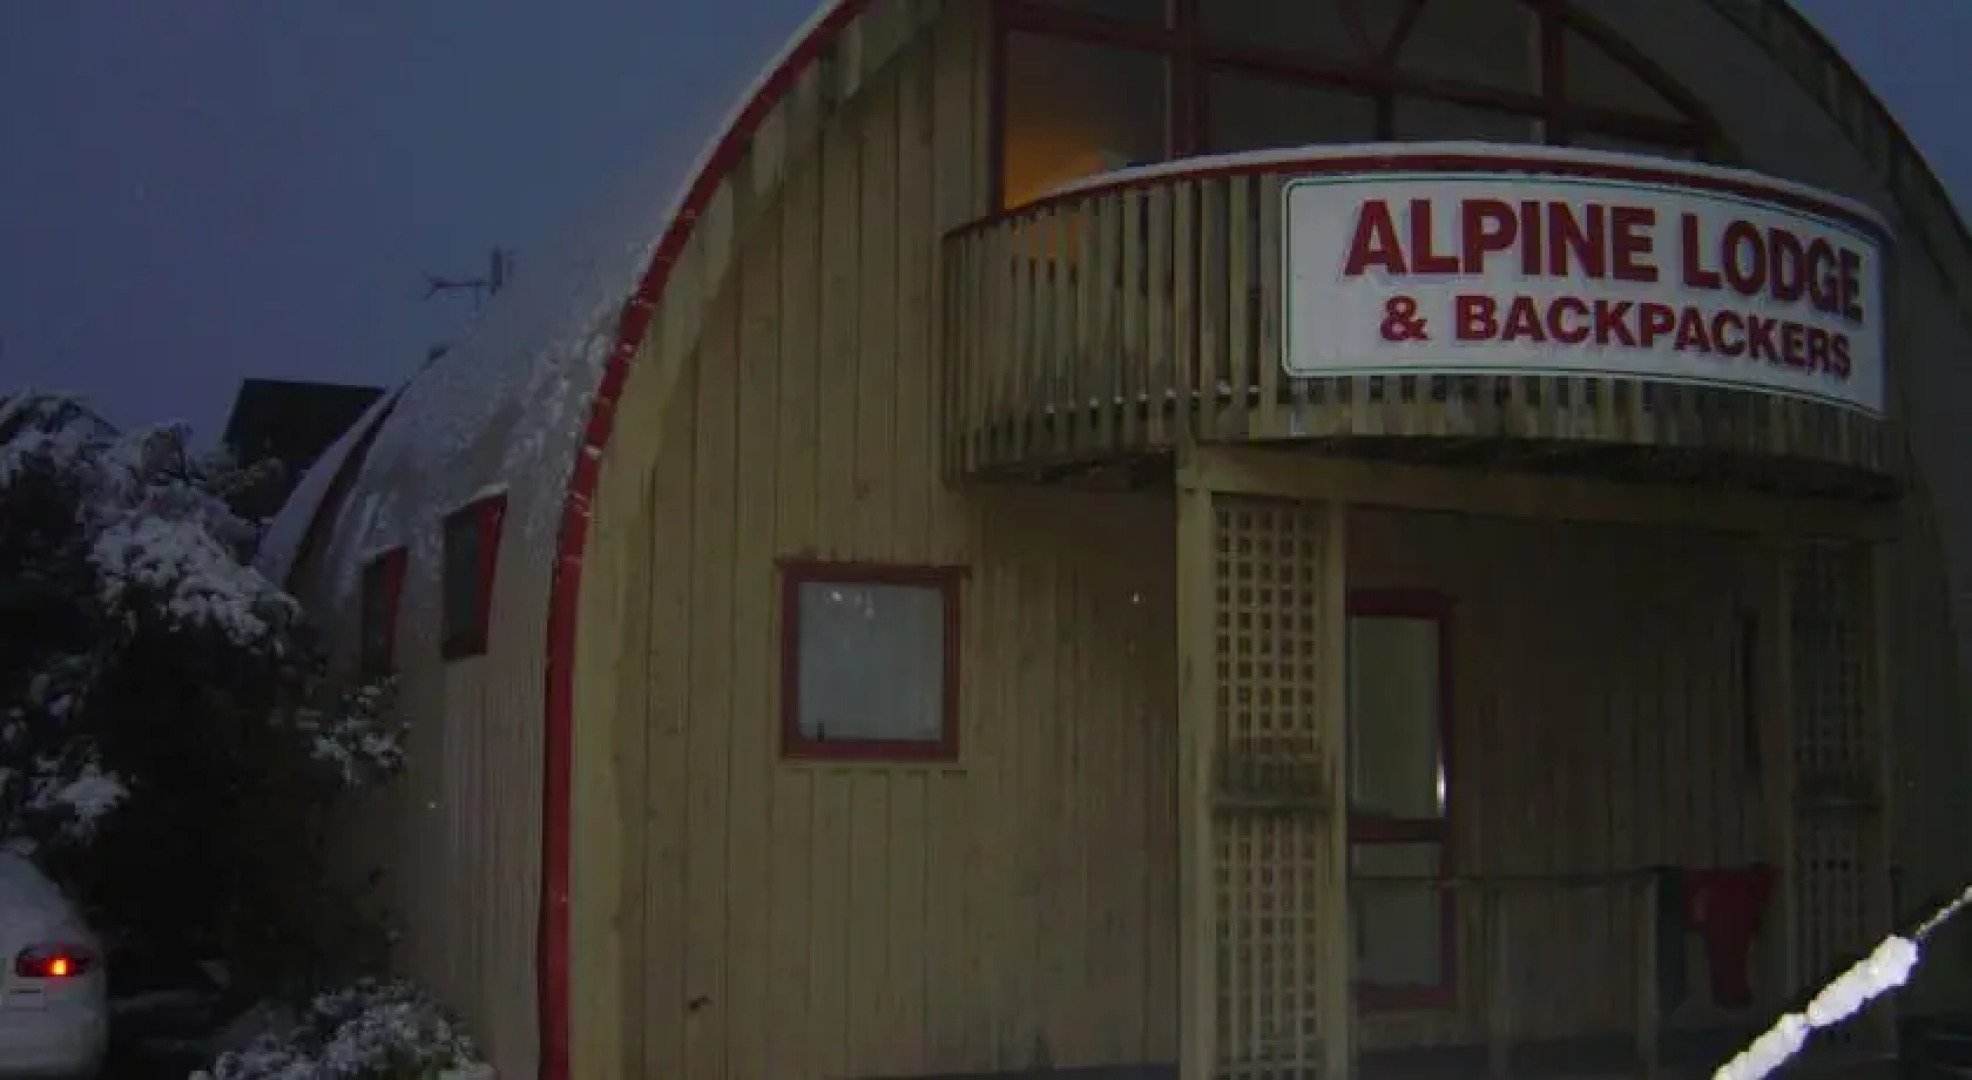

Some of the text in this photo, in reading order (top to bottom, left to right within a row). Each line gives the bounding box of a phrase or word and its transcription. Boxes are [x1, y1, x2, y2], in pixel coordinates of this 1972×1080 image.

[1344, 199, 1863, 323] ALPINE LODGE
[1380, 295, 1851, 379] & BACKPACKERS
